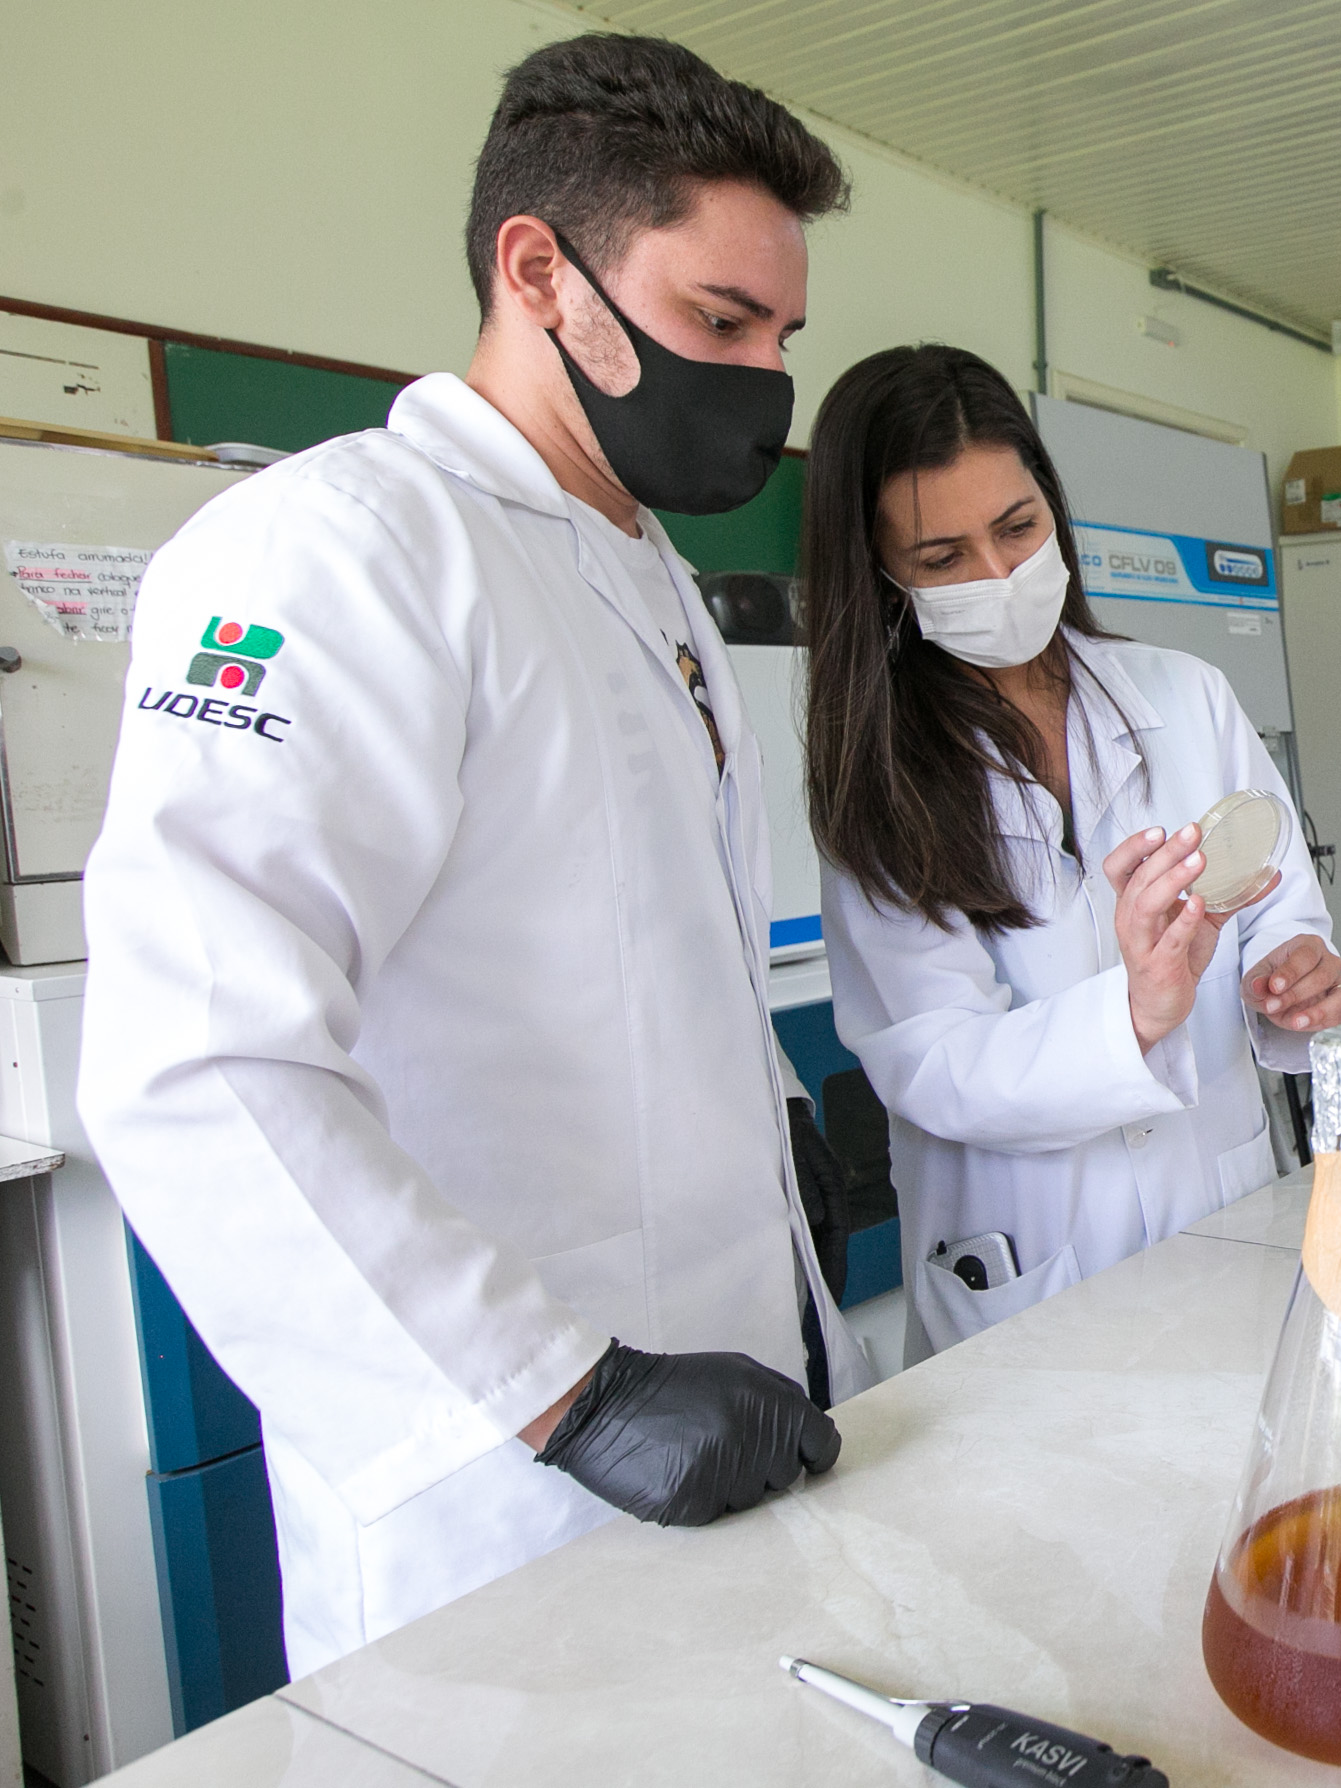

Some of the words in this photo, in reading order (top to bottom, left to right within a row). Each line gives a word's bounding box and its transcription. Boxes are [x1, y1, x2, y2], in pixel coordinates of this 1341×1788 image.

[19, 549, 66, 560] Estufa
[1109, 554, 1150, 573] CFLV
[17, 566, 45, 579] Para
[55, 568, 91, 579] fechar
[64, 587, 81, 595] na
[87, 586, 127, 596] vertical
[90, 607, 115, 621] gire
[138, 687, 292, 742] UDESC
[1010, 1732, 1088, 1777] KASVI
